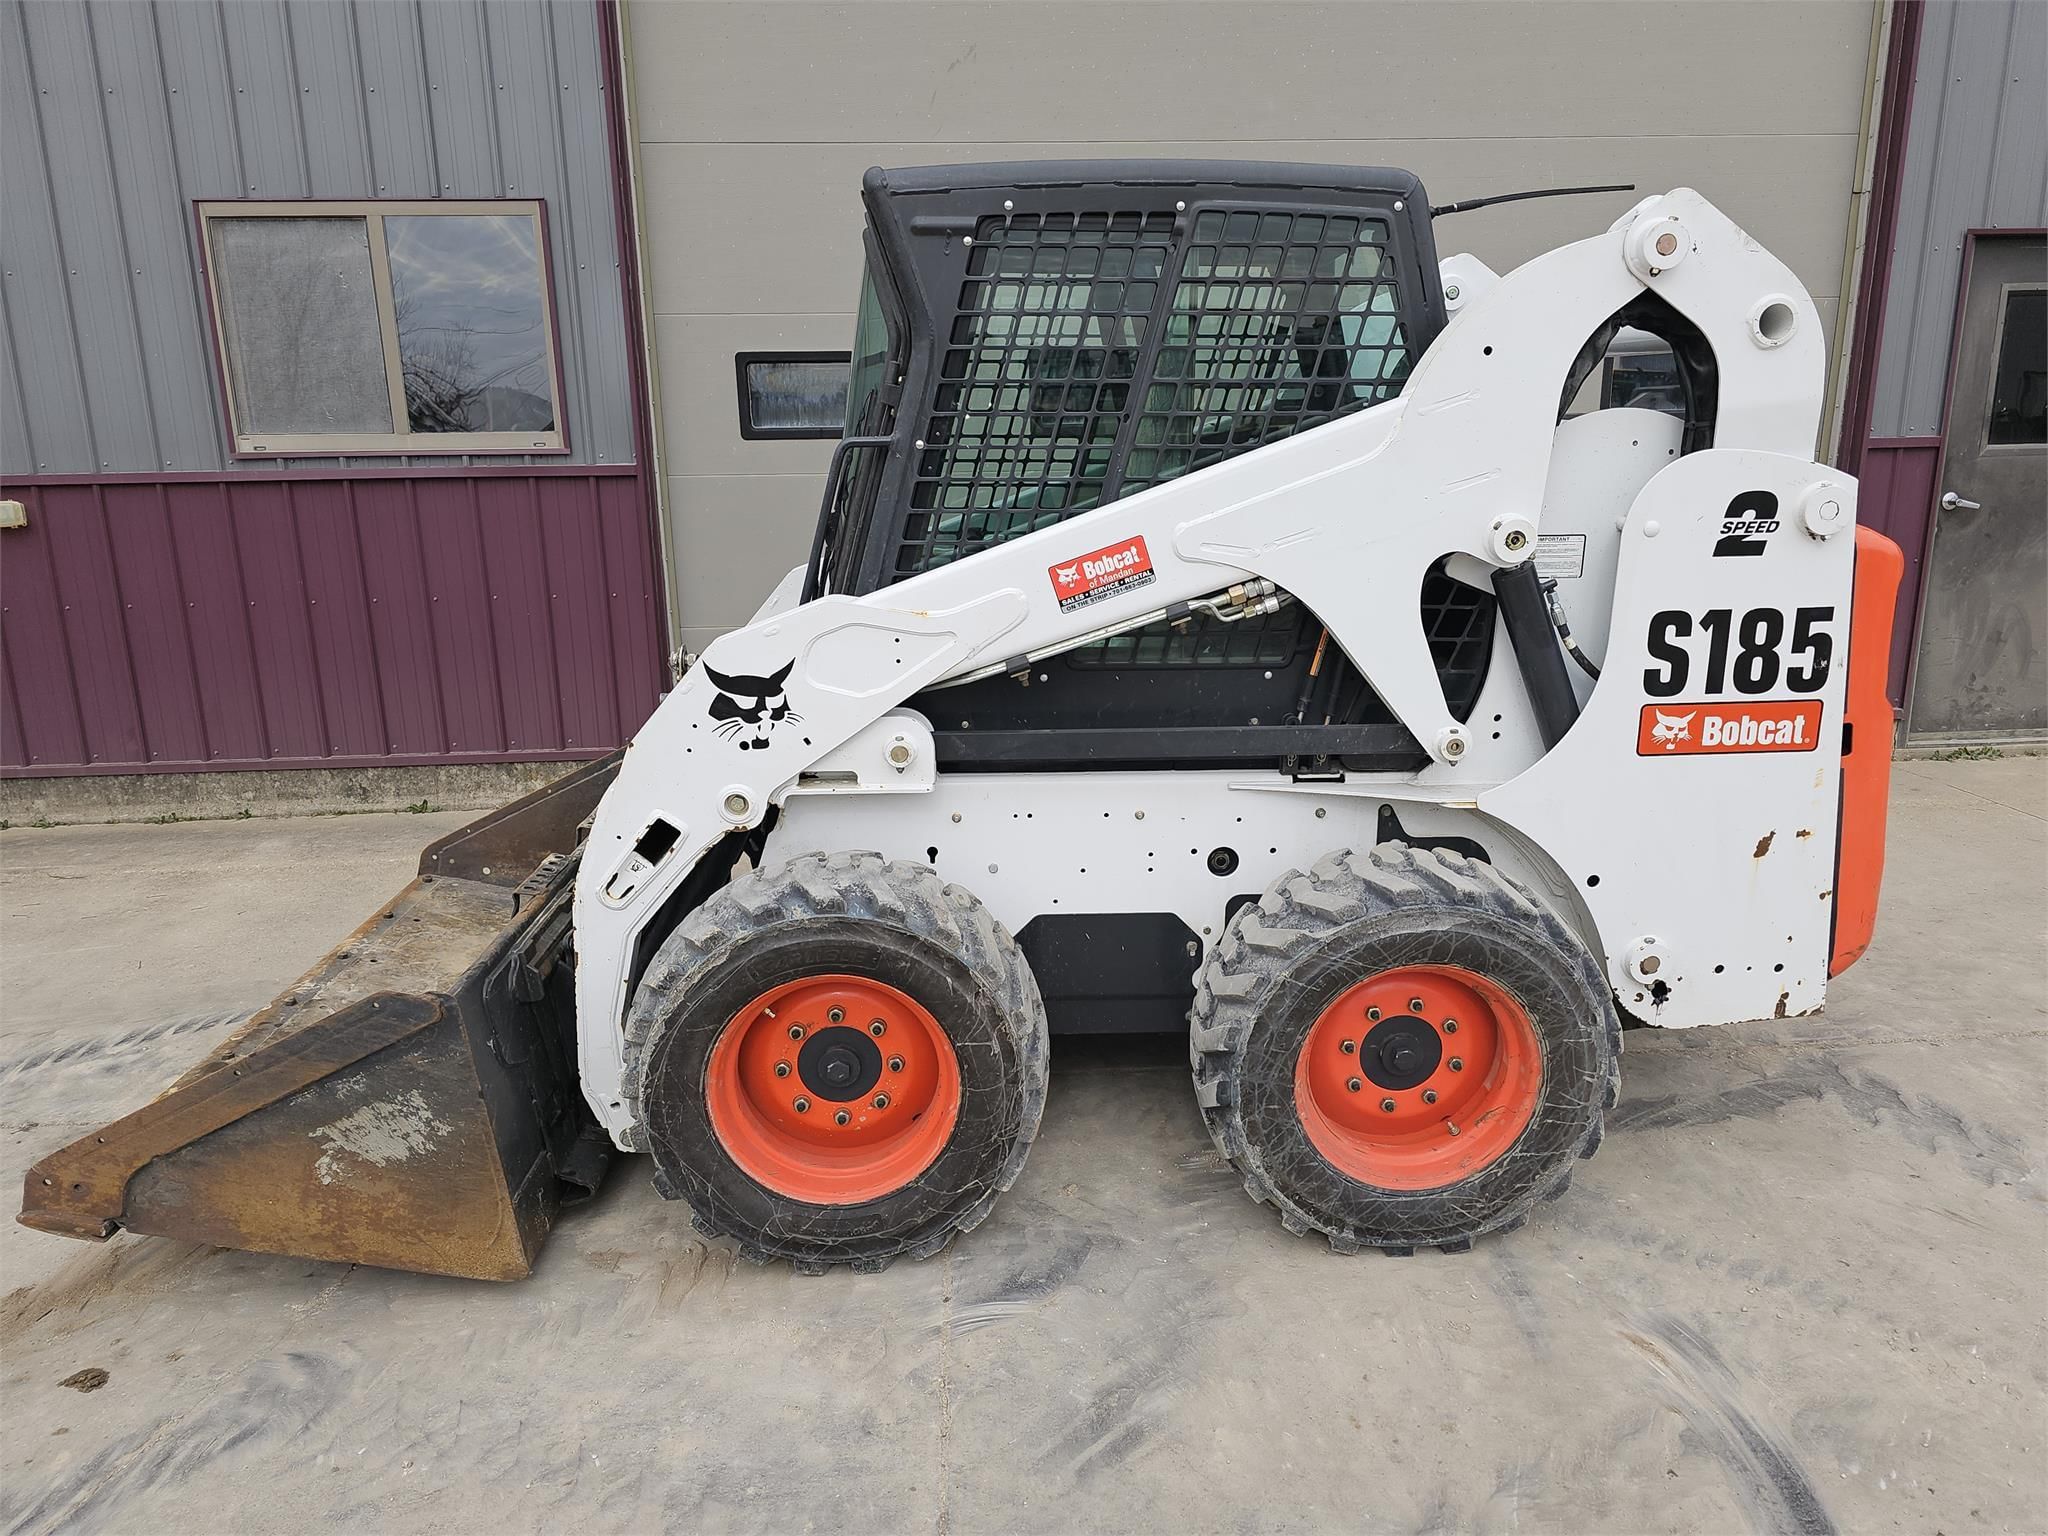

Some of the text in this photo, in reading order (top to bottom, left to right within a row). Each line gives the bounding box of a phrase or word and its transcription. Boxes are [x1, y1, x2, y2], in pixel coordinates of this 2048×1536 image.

[1712, 490, 1779, 557] 2
[1720, 521, 1780, 534] SPEED
[1082, 545, 1140, 580] Bobcat
[1089, 568, 1134, 589] of Mandan
[1061, 570, 1152, 606] SALES SERVICE RENTAL
[1066, 603, 1076, 612] ON
[1078, 599, 1089, 609] THE
[1090, 593, 1108, 604] STRIP
[1643, 606, 1835, 697] S185
[1701, 715, 1805, 747] Bobcat
